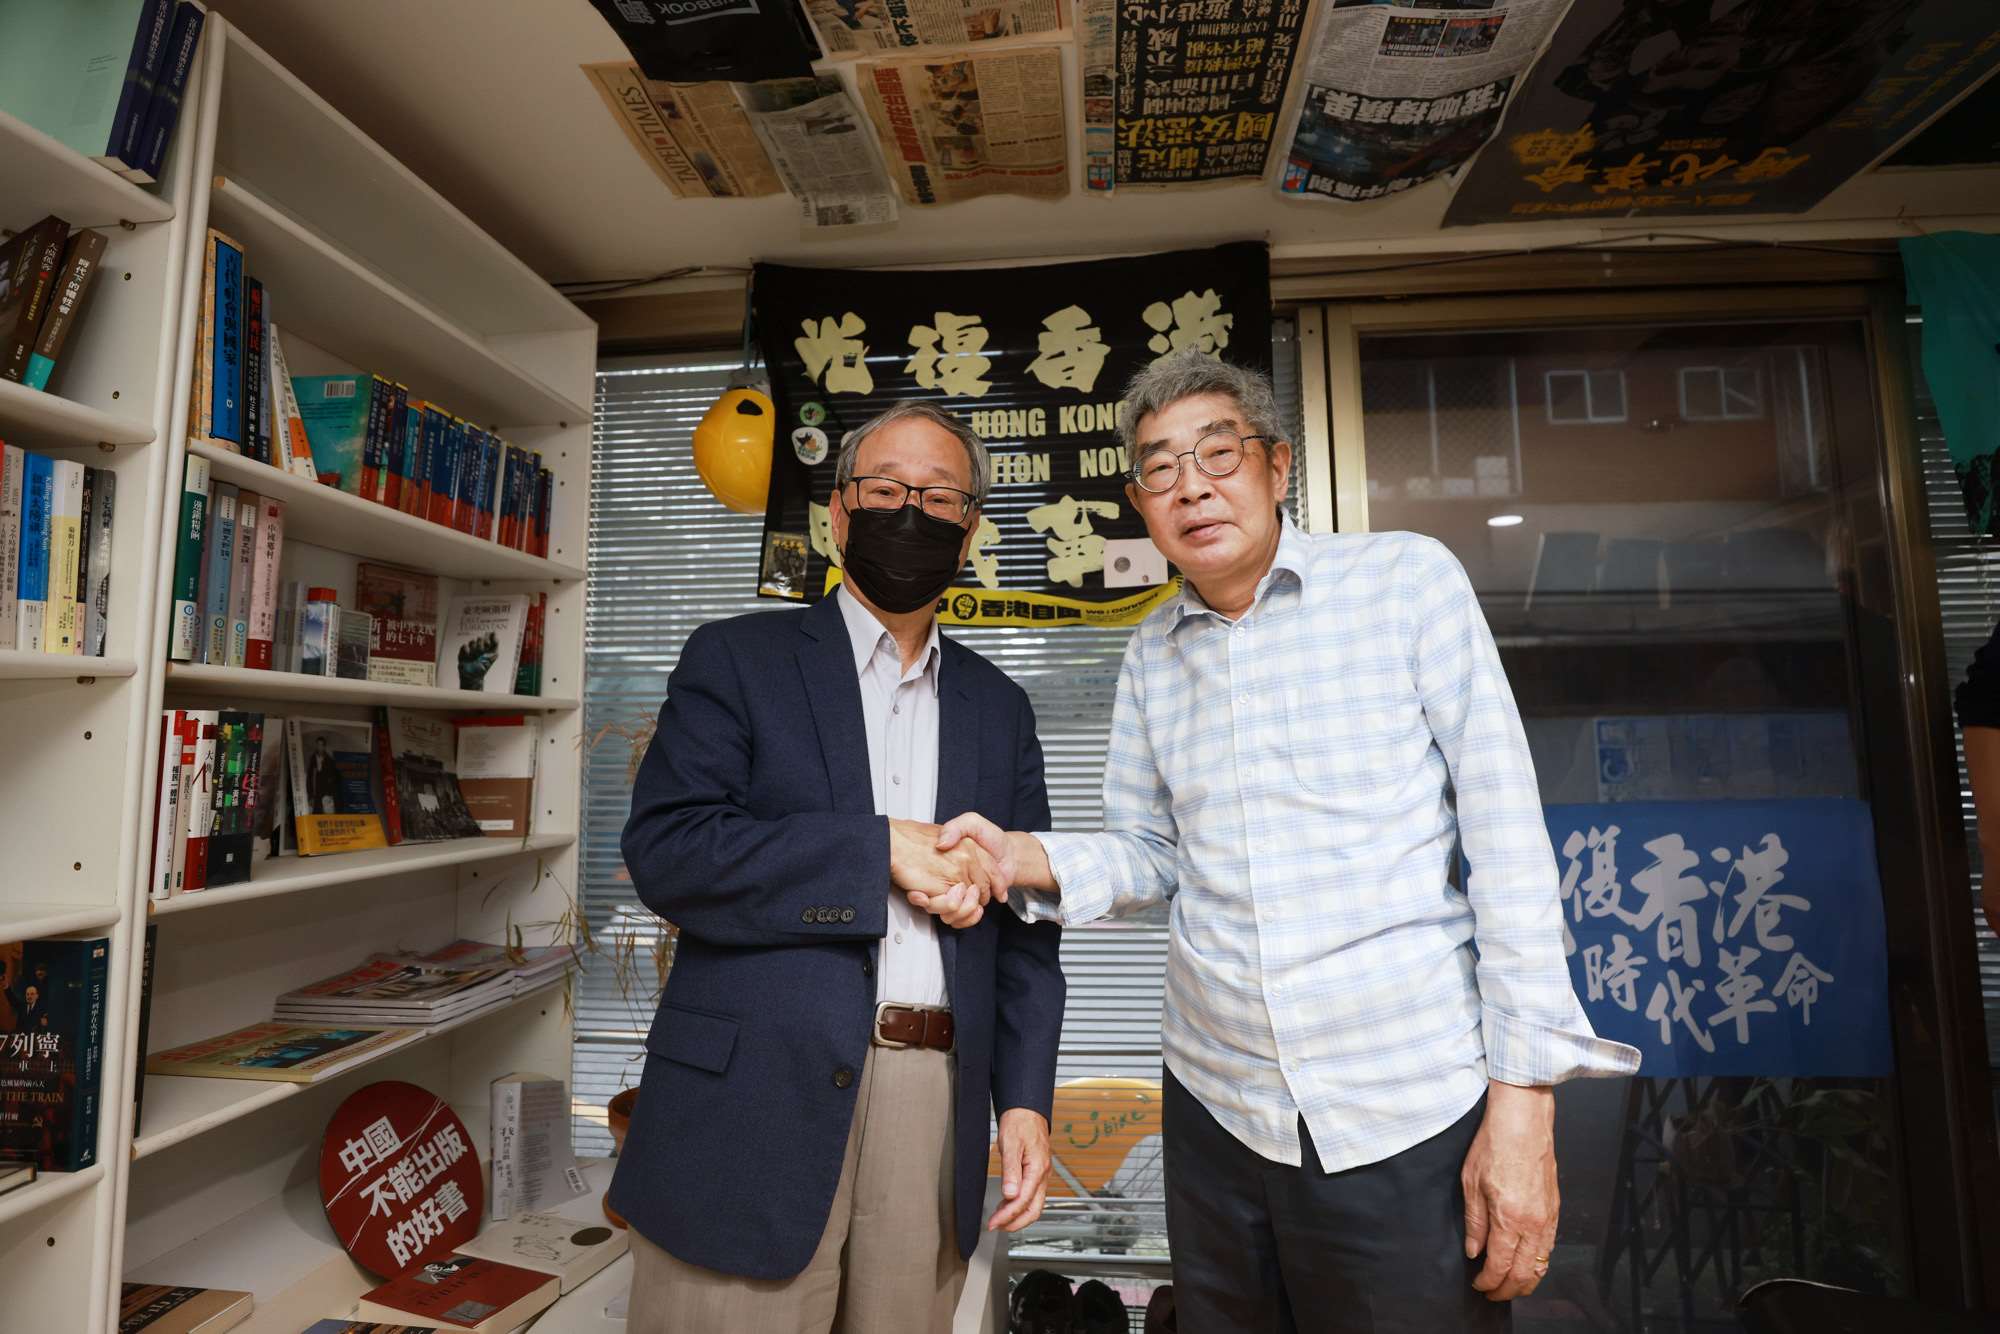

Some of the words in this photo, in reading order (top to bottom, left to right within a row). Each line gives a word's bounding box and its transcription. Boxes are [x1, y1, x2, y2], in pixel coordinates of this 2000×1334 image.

[617, 85, 665, 139] TIMES
[1117, 112, 1274, 147] 國安惡法
[656, 144, 699, 184] TAIPEI
[971, 408, 1047, 439] HONG
[1582, 933, 1835, 1053] 時代革命
[7, 1090, 28, 1103] THE
[31, 1090, 65, 1104] TRAIN
[338, 1115, 403, 1175] 中國
[359, 1122, 469, 1219] 不能出版
[385, 1179, 470, 1270] 的好書
